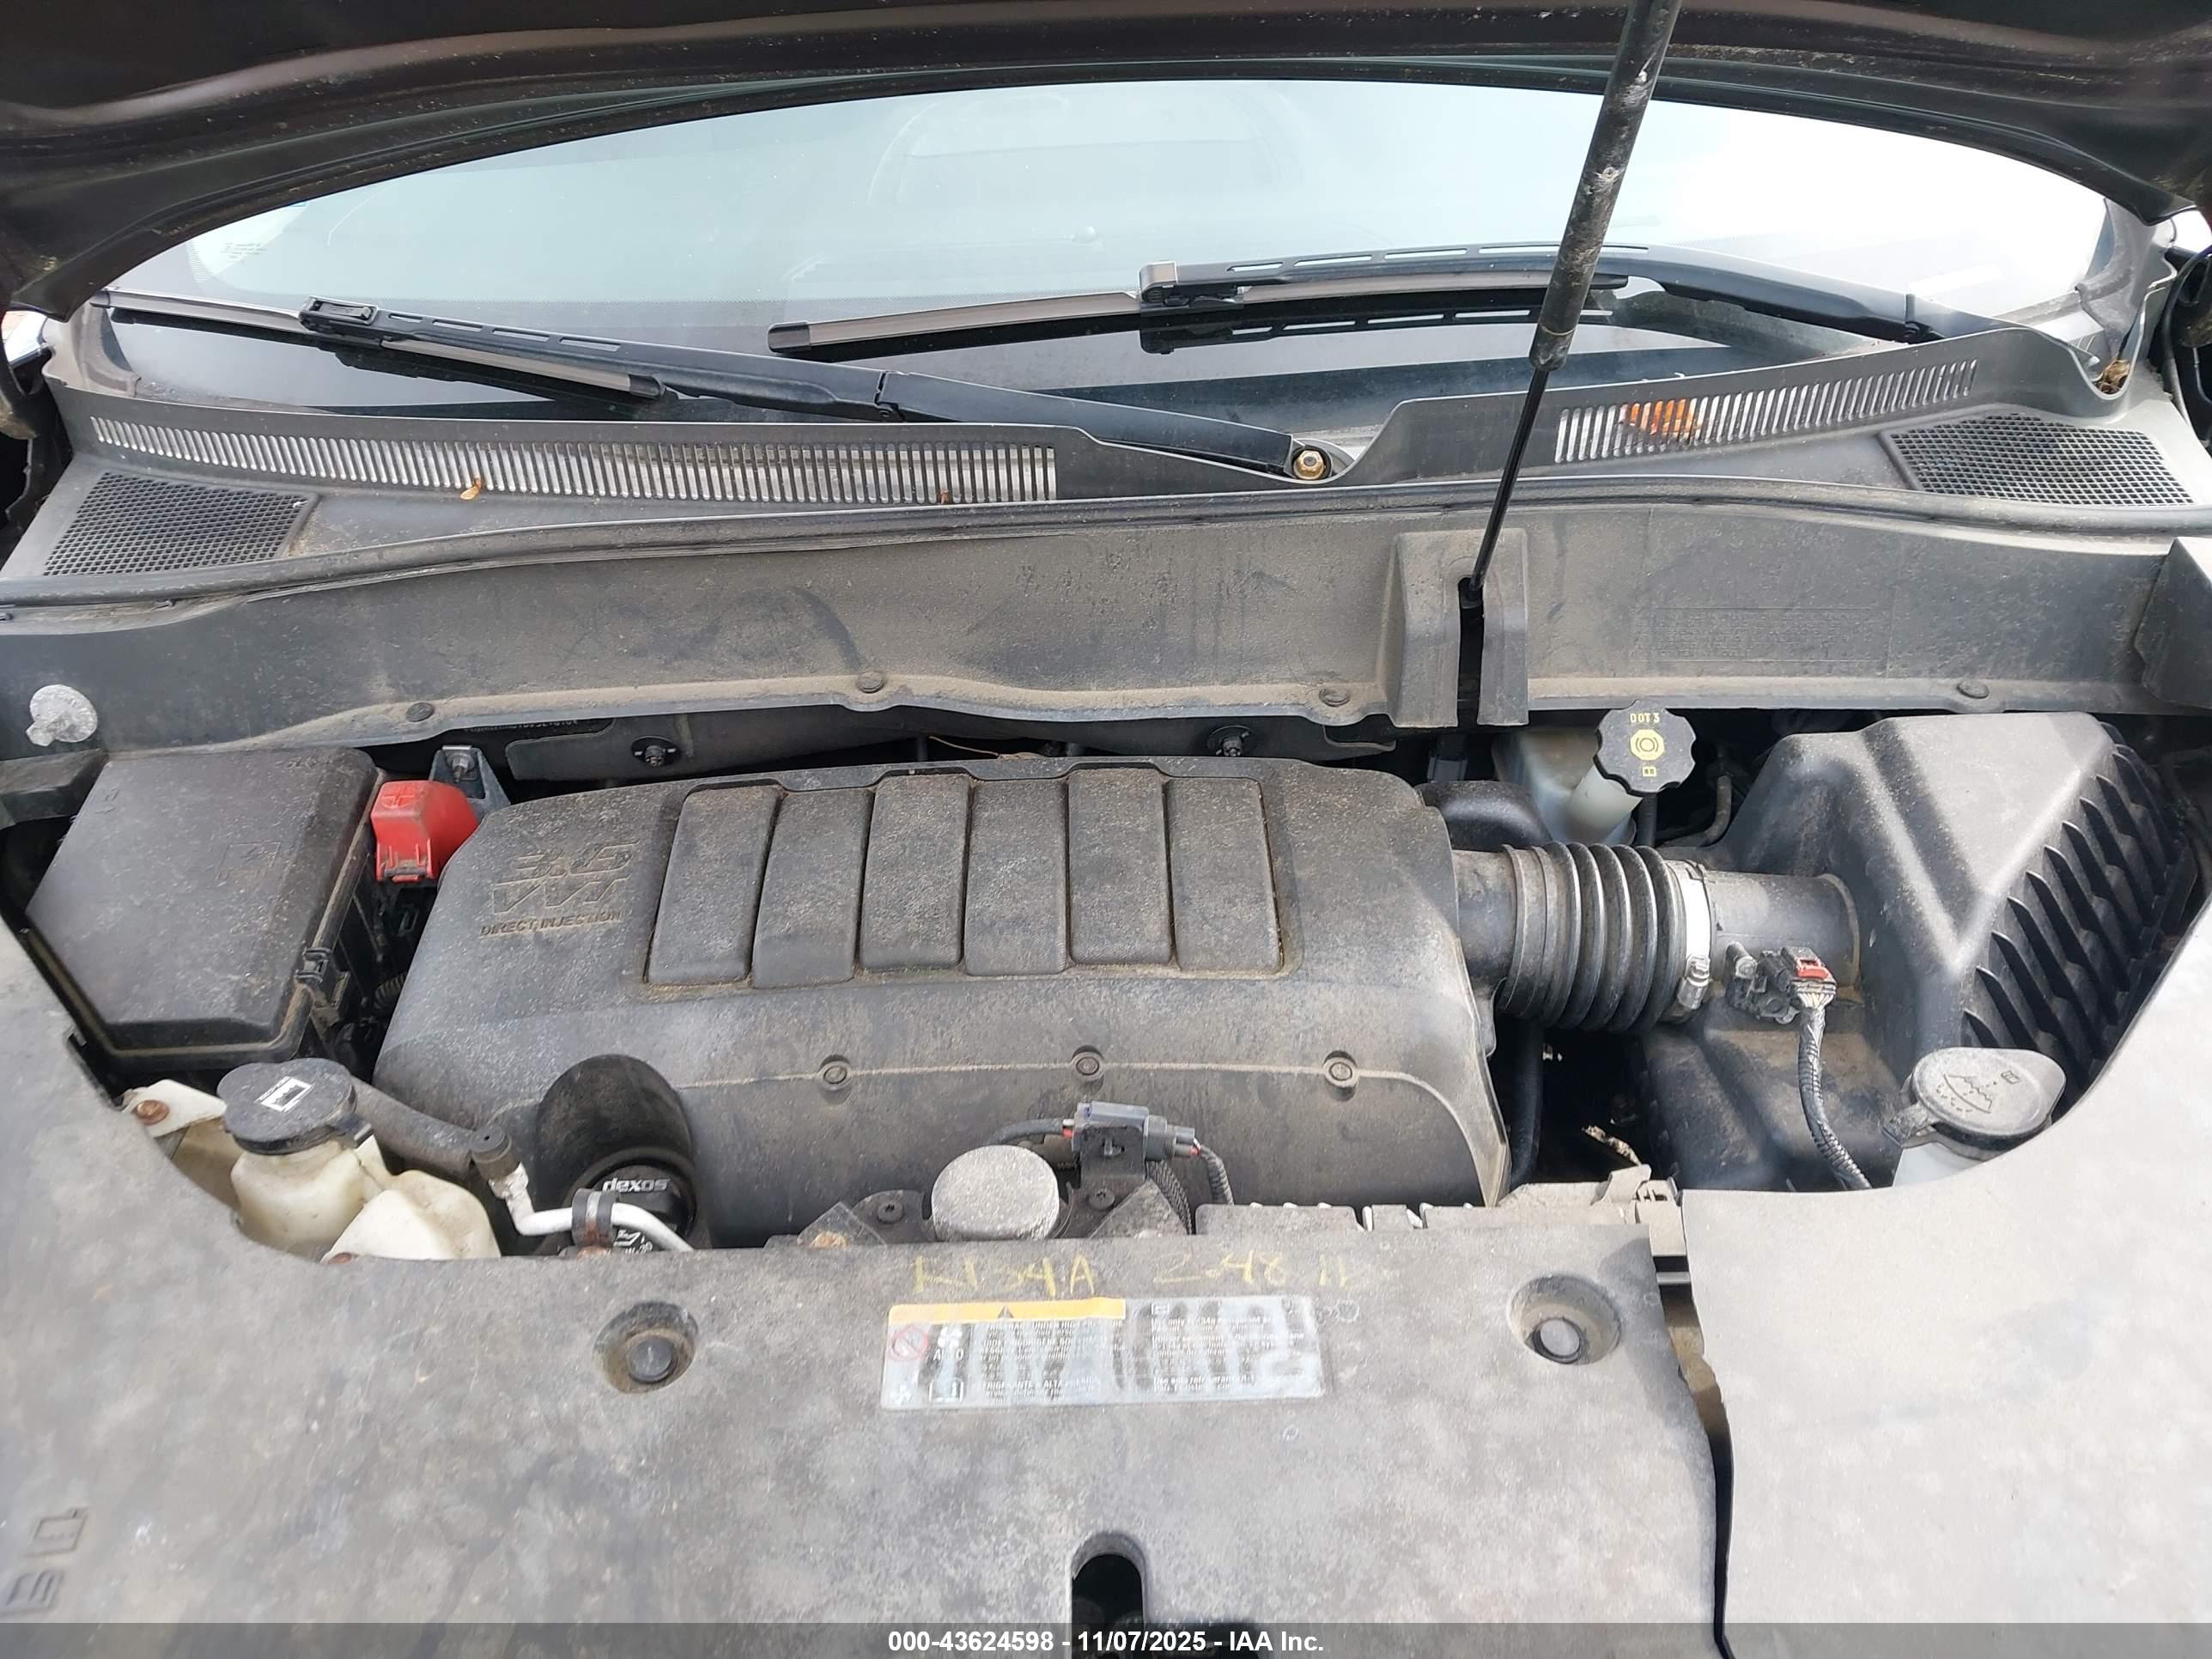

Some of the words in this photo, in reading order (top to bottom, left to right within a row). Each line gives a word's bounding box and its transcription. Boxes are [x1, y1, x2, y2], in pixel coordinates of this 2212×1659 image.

[1653, 712, 1661, 723] 3
[480, 919, 538, 936] DIRECT
[539, 910, 621, 929] INJECTION
[603, 1177, 672, 1193] dexos
